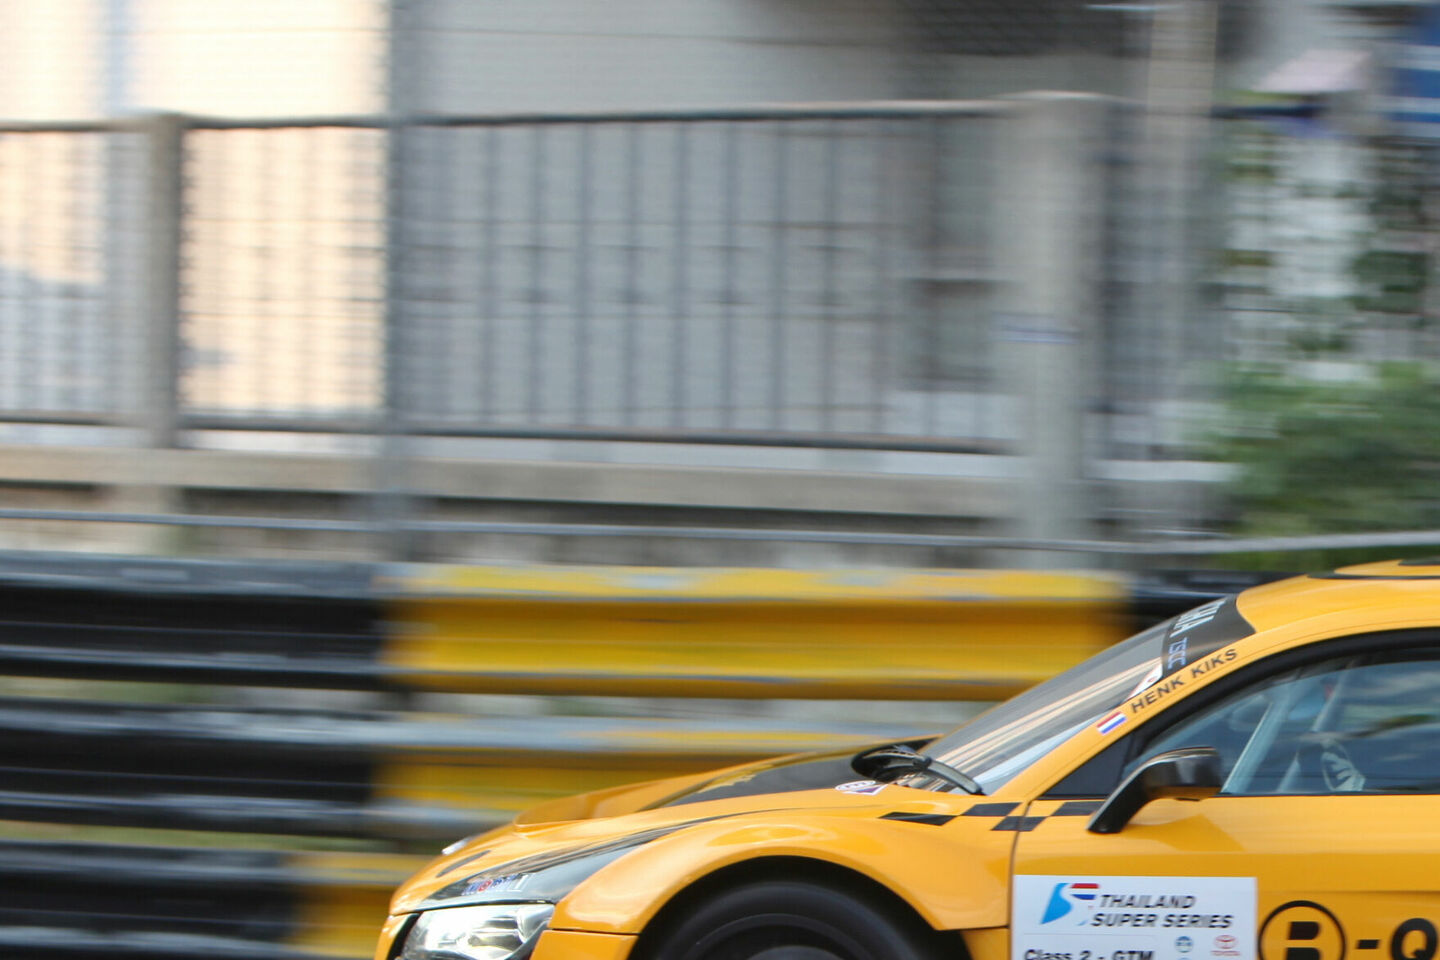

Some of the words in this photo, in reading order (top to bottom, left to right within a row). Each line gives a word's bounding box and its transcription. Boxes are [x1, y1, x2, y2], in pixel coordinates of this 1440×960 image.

[1130, 675, 1185, 714] HENK
[1190, 648, 1238, 678] KIKS
[1101, 894, 1196, 909] THAILAND
[1091, 913, 1157, 927] SUPER
[1163, 914, 1234, 929] SERIES
